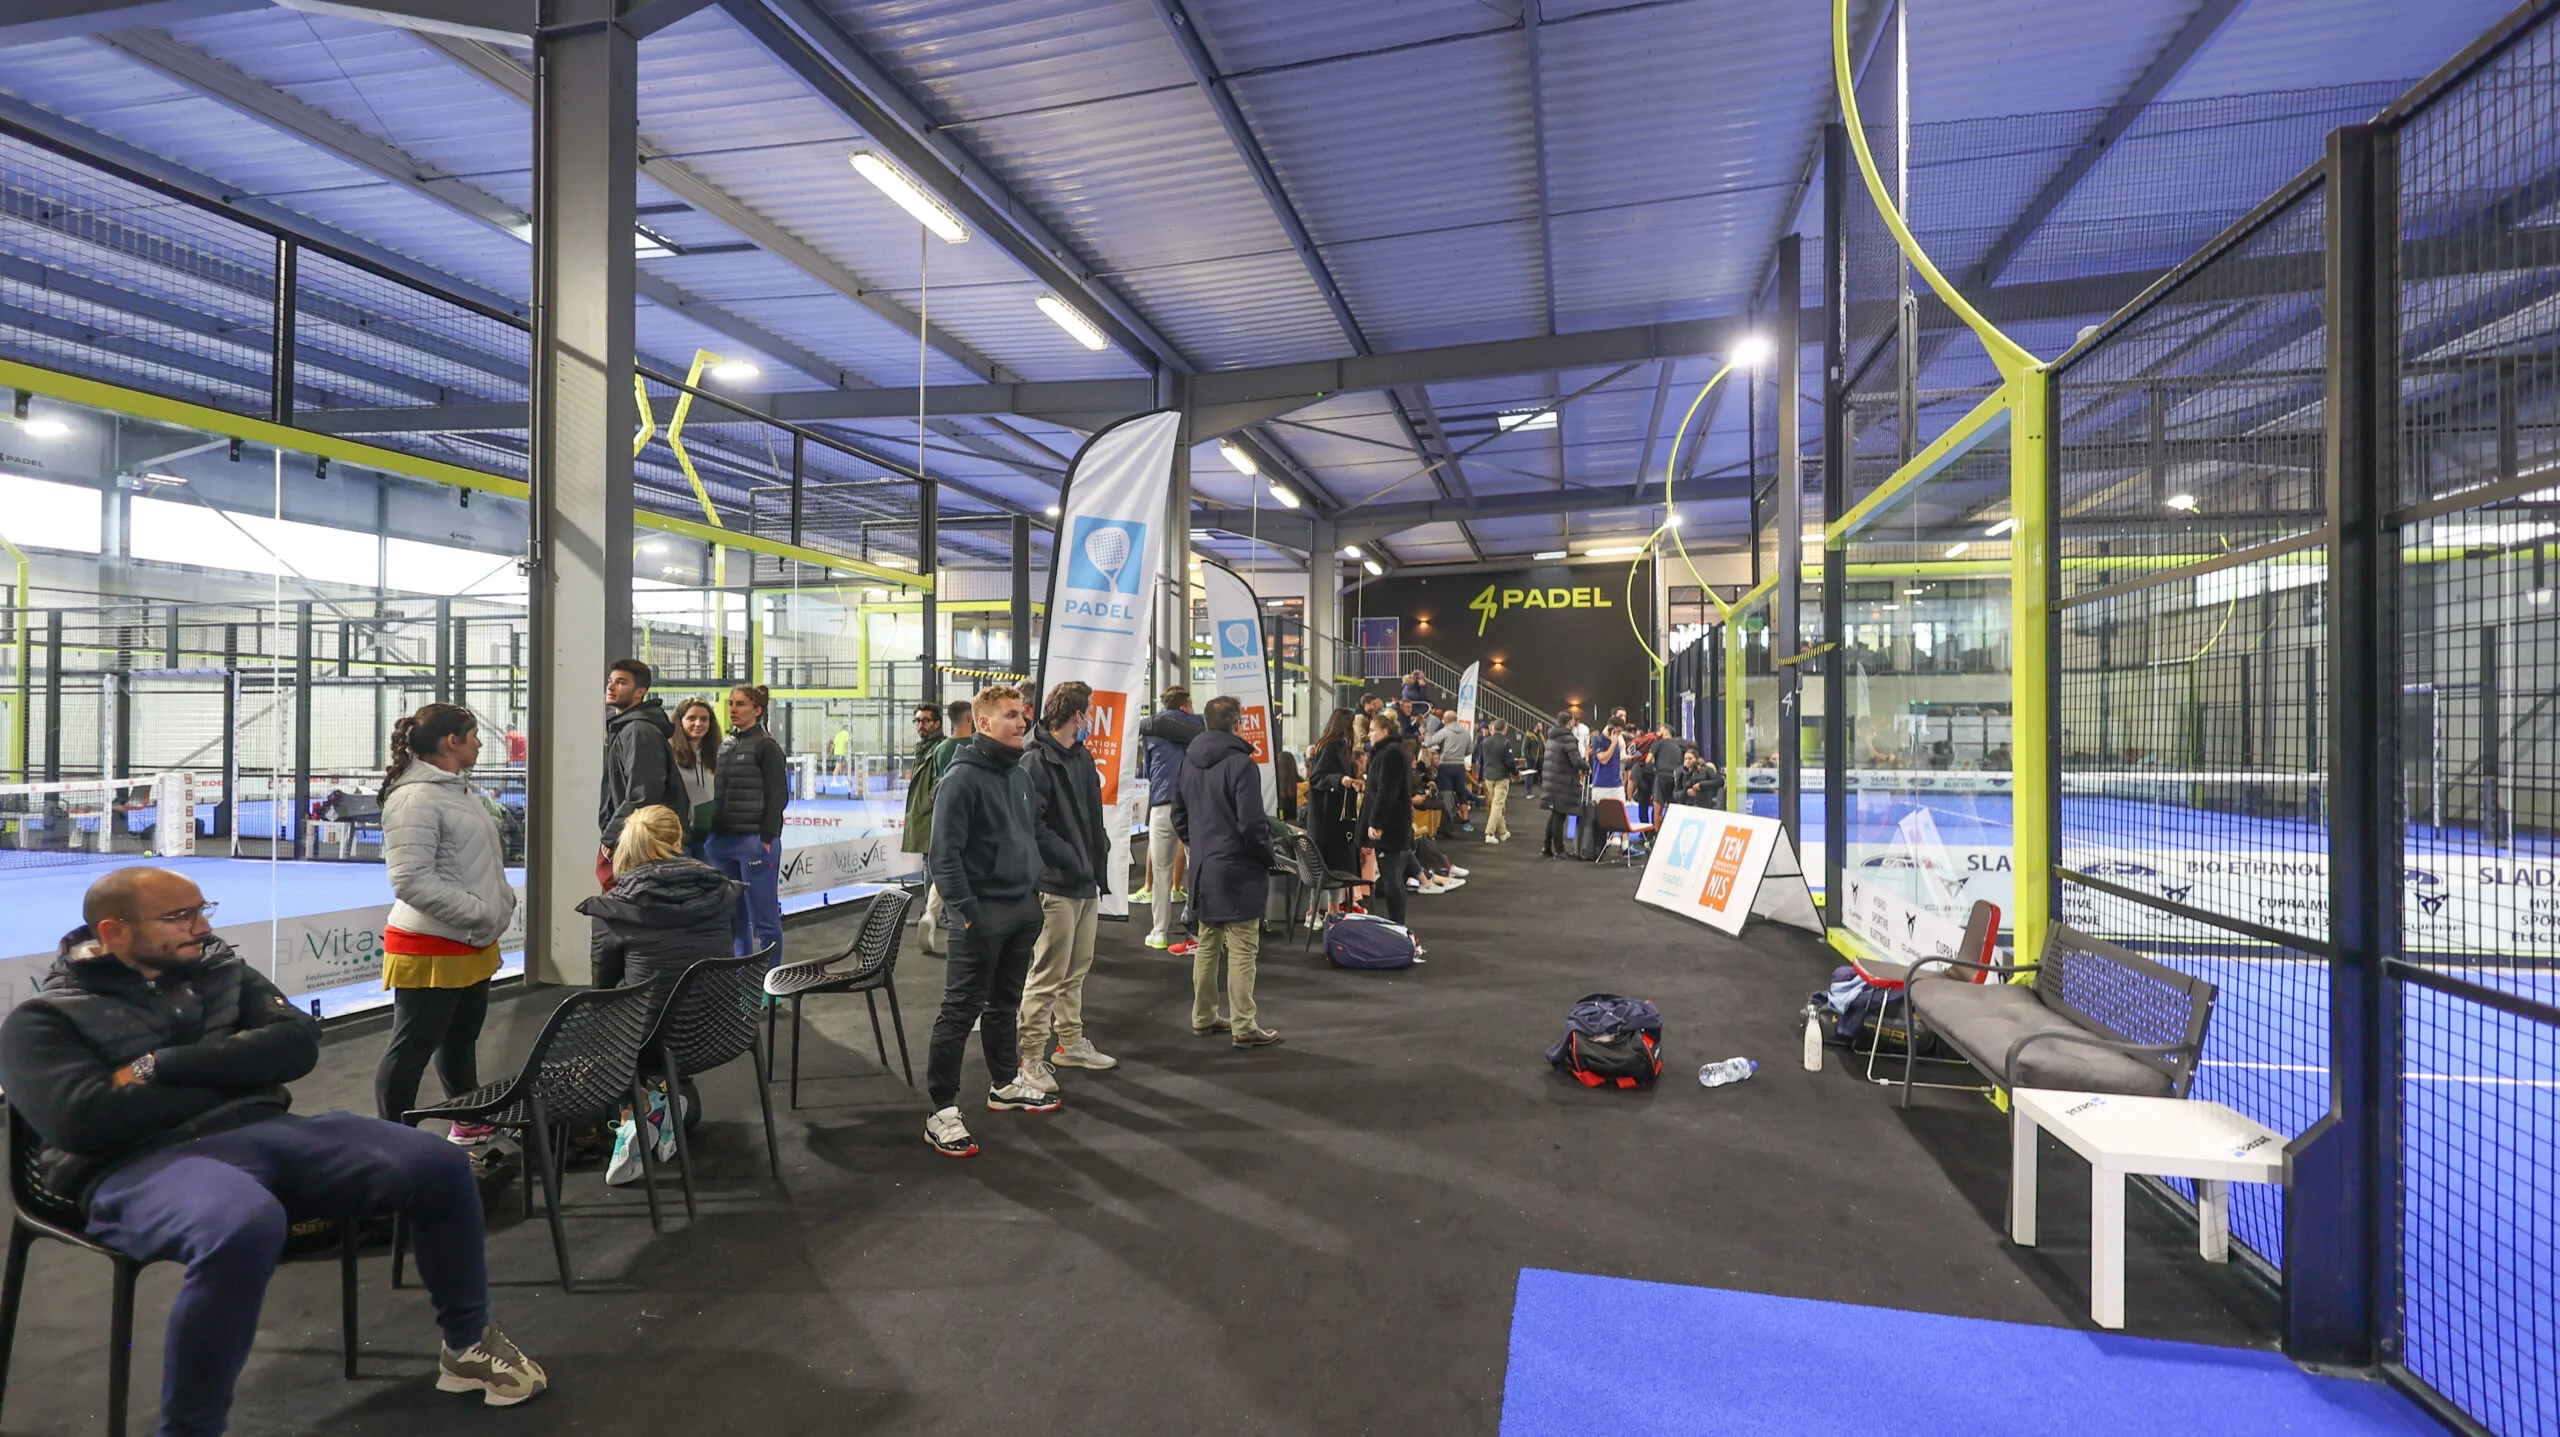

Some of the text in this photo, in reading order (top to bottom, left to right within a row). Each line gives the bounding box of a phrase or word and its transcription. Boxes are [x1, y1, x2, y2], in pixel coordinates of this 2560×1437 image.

[6, 455, 45, 468] PADEL
[1065, 600, 1134, 620] PADEL
[1469, 584, 1612, 637] 4 PADEL
[1223, 661, 1259, 672] PADEL
[1720, 836, 1746, 863] TEN
[1967, 854, 2012, 872] SLA
[1706, 873, 1731, 900] NIS
[306, 927, 374, 960] Vita
